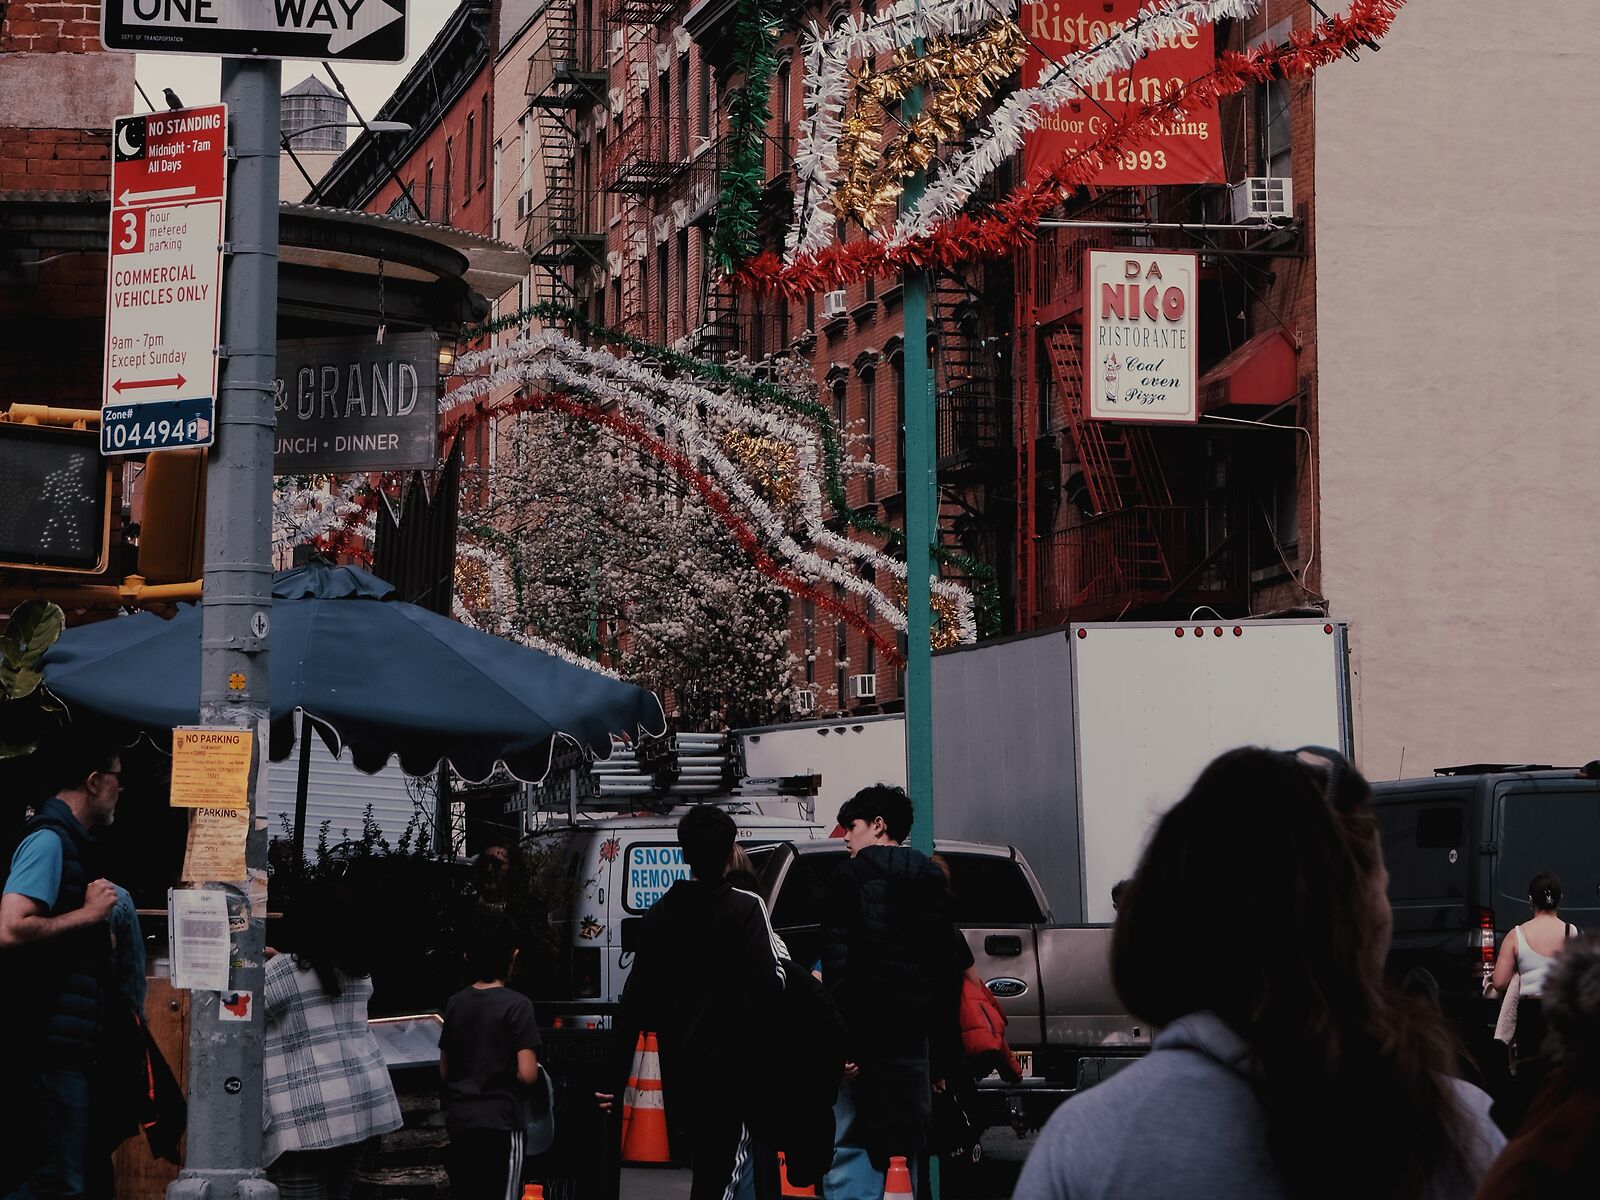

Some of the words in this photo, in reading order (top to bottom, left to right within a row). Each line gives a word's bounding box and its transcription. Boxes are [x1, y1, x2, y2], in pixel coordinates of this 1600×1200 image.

[1031, 2, 1199, 50] Ristorte
[149, 121, 164, 137] NO
[167, 114, 221, 135] STANDING
[1038, 112, 1085, 134] utdoor
[149, 142, 185, 160] Midnight
[192, 140, 211, 153] 7am
[148, 161, 160, 174] All
[162, 159, 182, 174] Days
[119, 212, 138, 250] 3
[149, 211, 170, 224] hour
[150, 223, 187, 237] metered
[149, 239, 182, 254] parking
[115, 264, 196, 287] COMMERCIAL
[1125, 260, 1163, 280] DA
[115, 287, 173, 308] VEHICLES
[177, 284, 209, 302] ONLY
[1101, 282, 1185, 322] NICO
[112, 336, 133, 350] 9am
[143, 333, 164, 350] 7pm
[1099, 325, 1186, 349] RISTORANTE
[112, 351, 146, 369] Except
[149, 350, 187, 367] Sunday
[1125, 355, 1165, 373] Coal
[297, 361, 418, 420] GRAND
[1141, 375, 1181, 388] oven
[1124, 388, 1167, 406] Pizza
[105, 408, 133, 421] Zone#
[105, 418, 184, 449] 104494
[335, 433, 400, 452] DINNER
[186, 734, 199, 743] NO
[201, 734, 240, 744] PARKING
[198, 807, 237, 818] PARKING
[634, 848, 687, 865] SNOW
